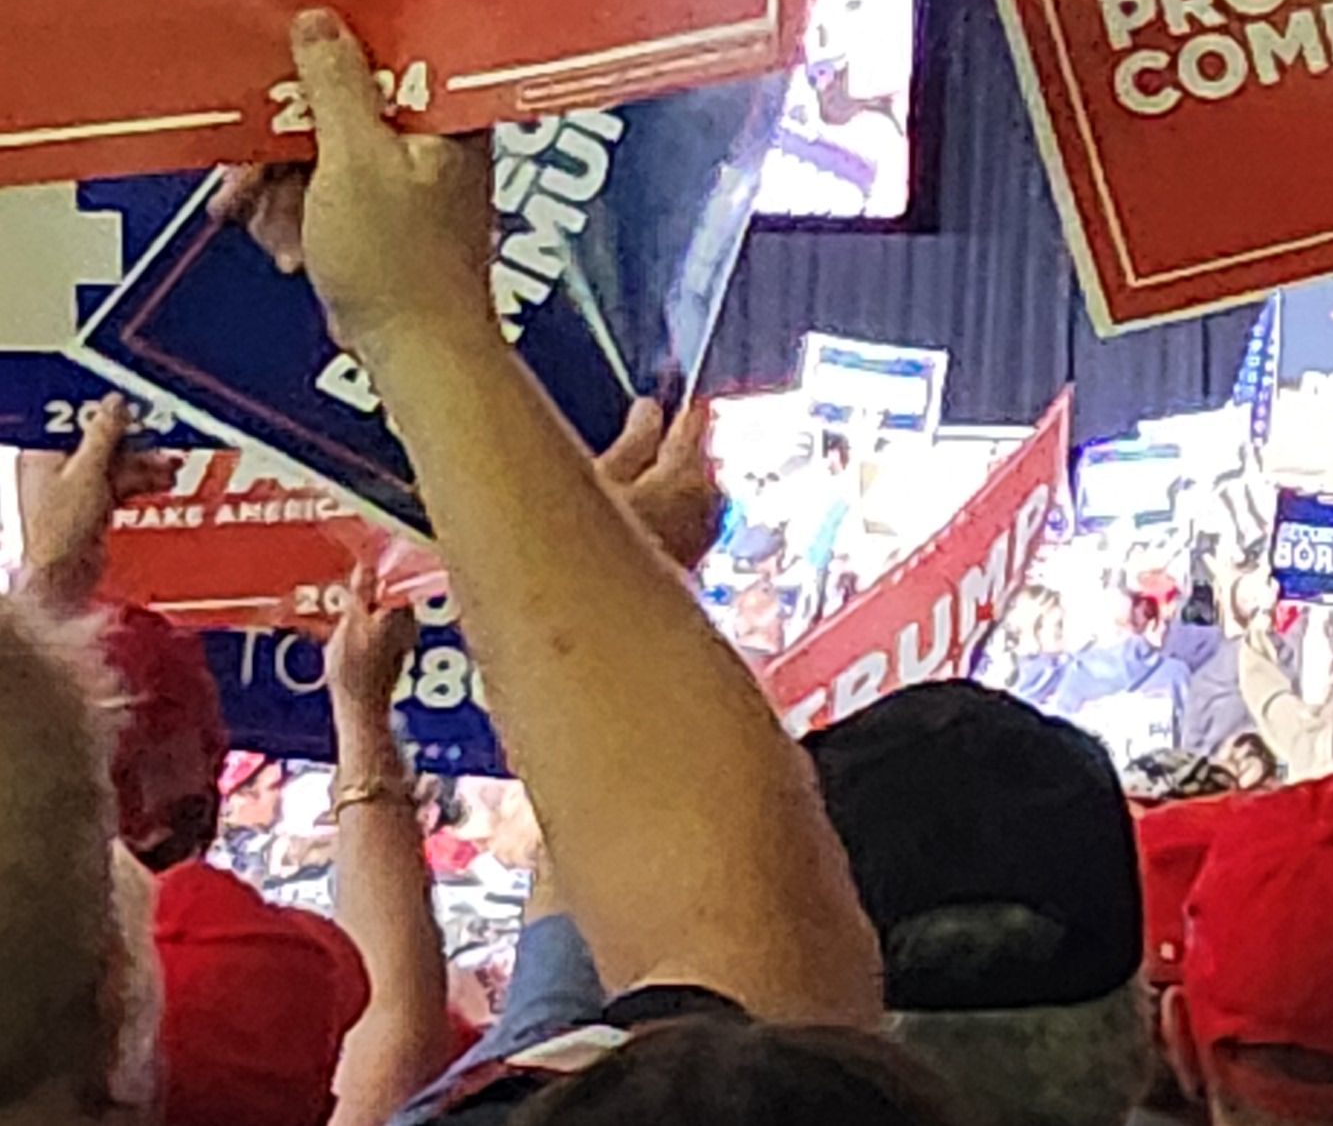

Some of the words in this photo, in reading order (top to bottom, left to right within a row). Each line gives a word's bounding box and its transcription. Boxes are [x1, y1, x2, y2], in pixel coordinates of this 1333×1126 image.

[269, 60, 429, 134] 24
[112, 504, 203, 530] MAKE
[214, 497, 358, 525] AMERIC
